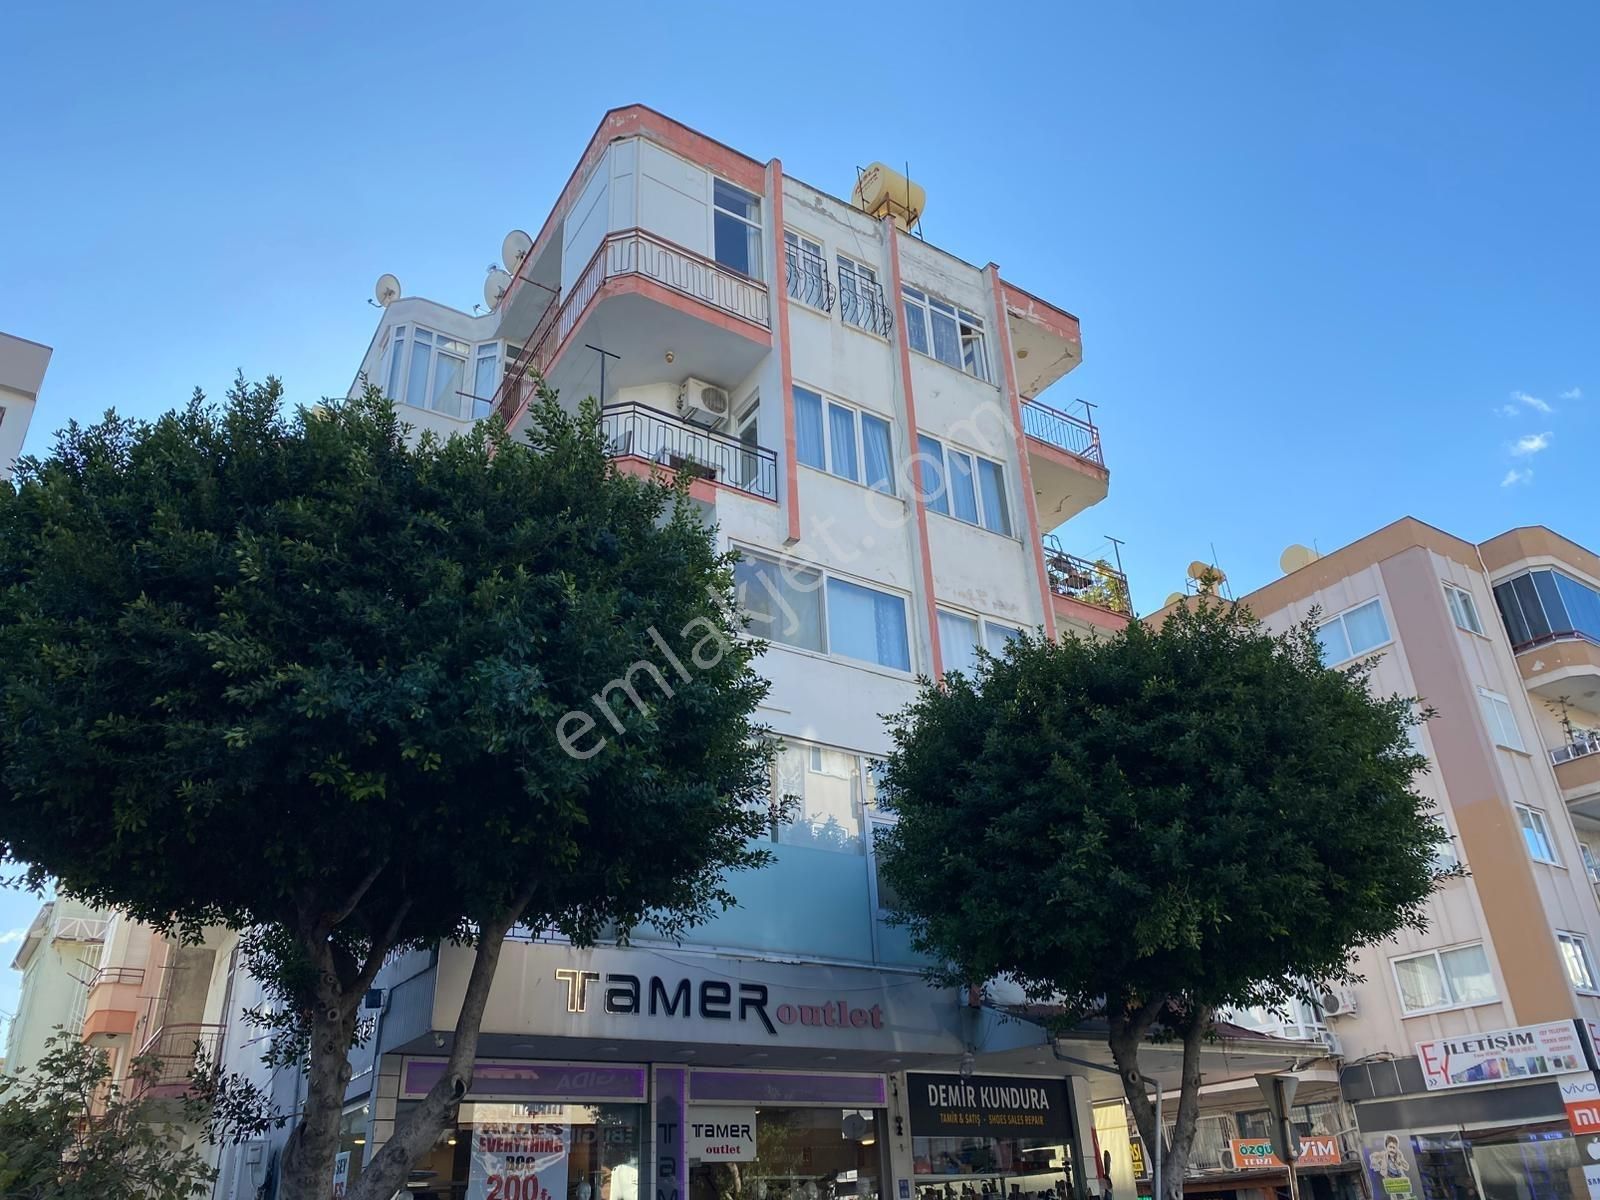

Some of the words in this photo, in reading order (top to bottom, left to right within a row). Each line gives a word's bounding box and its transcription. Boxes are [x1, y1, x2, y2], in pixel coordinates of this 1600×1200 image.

[776, 1000, 884, 1029] outlet
[1443, 1032, 1535, 1056] İLETİŞİM
[928, 1079, 977, 1108] DEMİR
[980, 1086, 1050, 1110] KUNDURA
[1562, 1083, 1597, 1094] vivo
[989, 1114, 1007, 1124] SHOES
[1008, 1114, 1024, 1125] SALES
[1025, 1115, 1044, 1125] REPAIR
[479, 1137, 563, 1153] EVERYTHING
[706, 1145, 741, 1154] outlet
